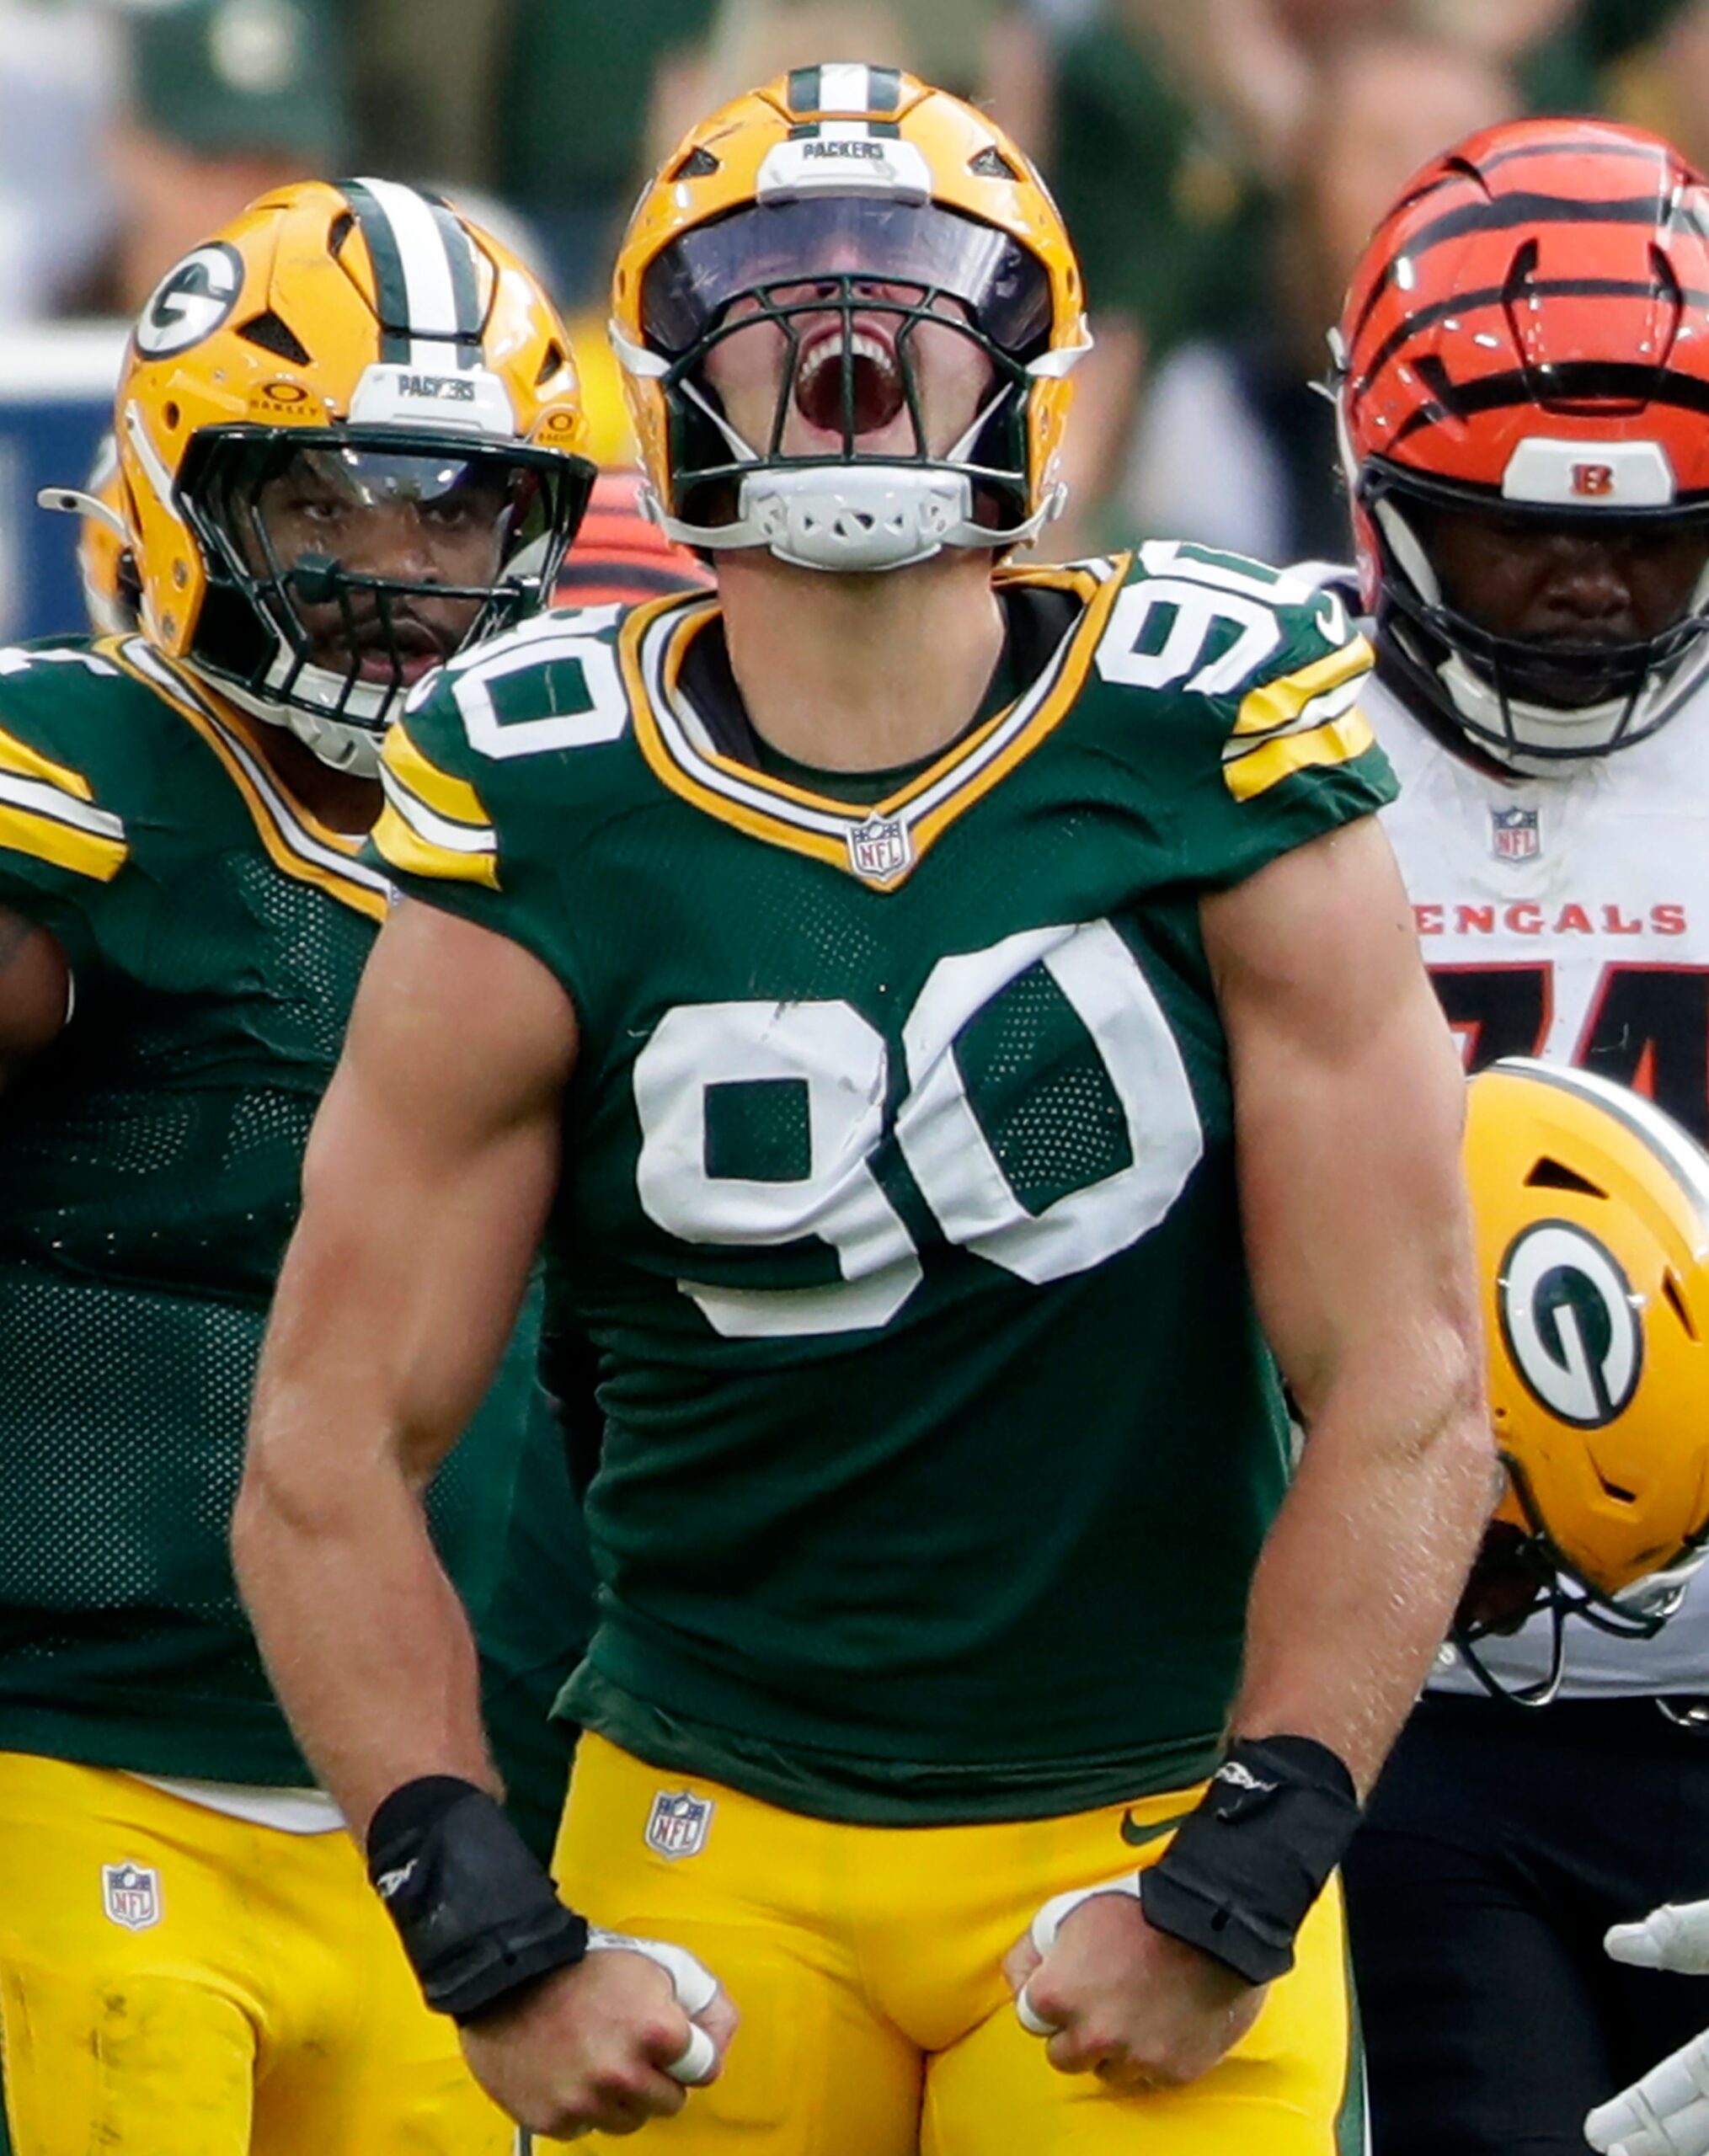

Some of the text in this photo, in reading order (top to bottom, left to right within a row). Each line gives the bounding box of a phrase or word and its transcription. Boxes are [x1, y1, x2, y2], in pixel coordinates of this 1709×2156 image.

[803, 141, 884, 160] PACKERS
[1571, 463, 1614, 496] B
[858, 838, 902, 868] NFL
[1498, 829, 1536, 856] NFL
[633, 918, 1204, 1337] 90
[654, 1815, 694, 1848] NFL
[113, 1892, 150, 1919] NFL
